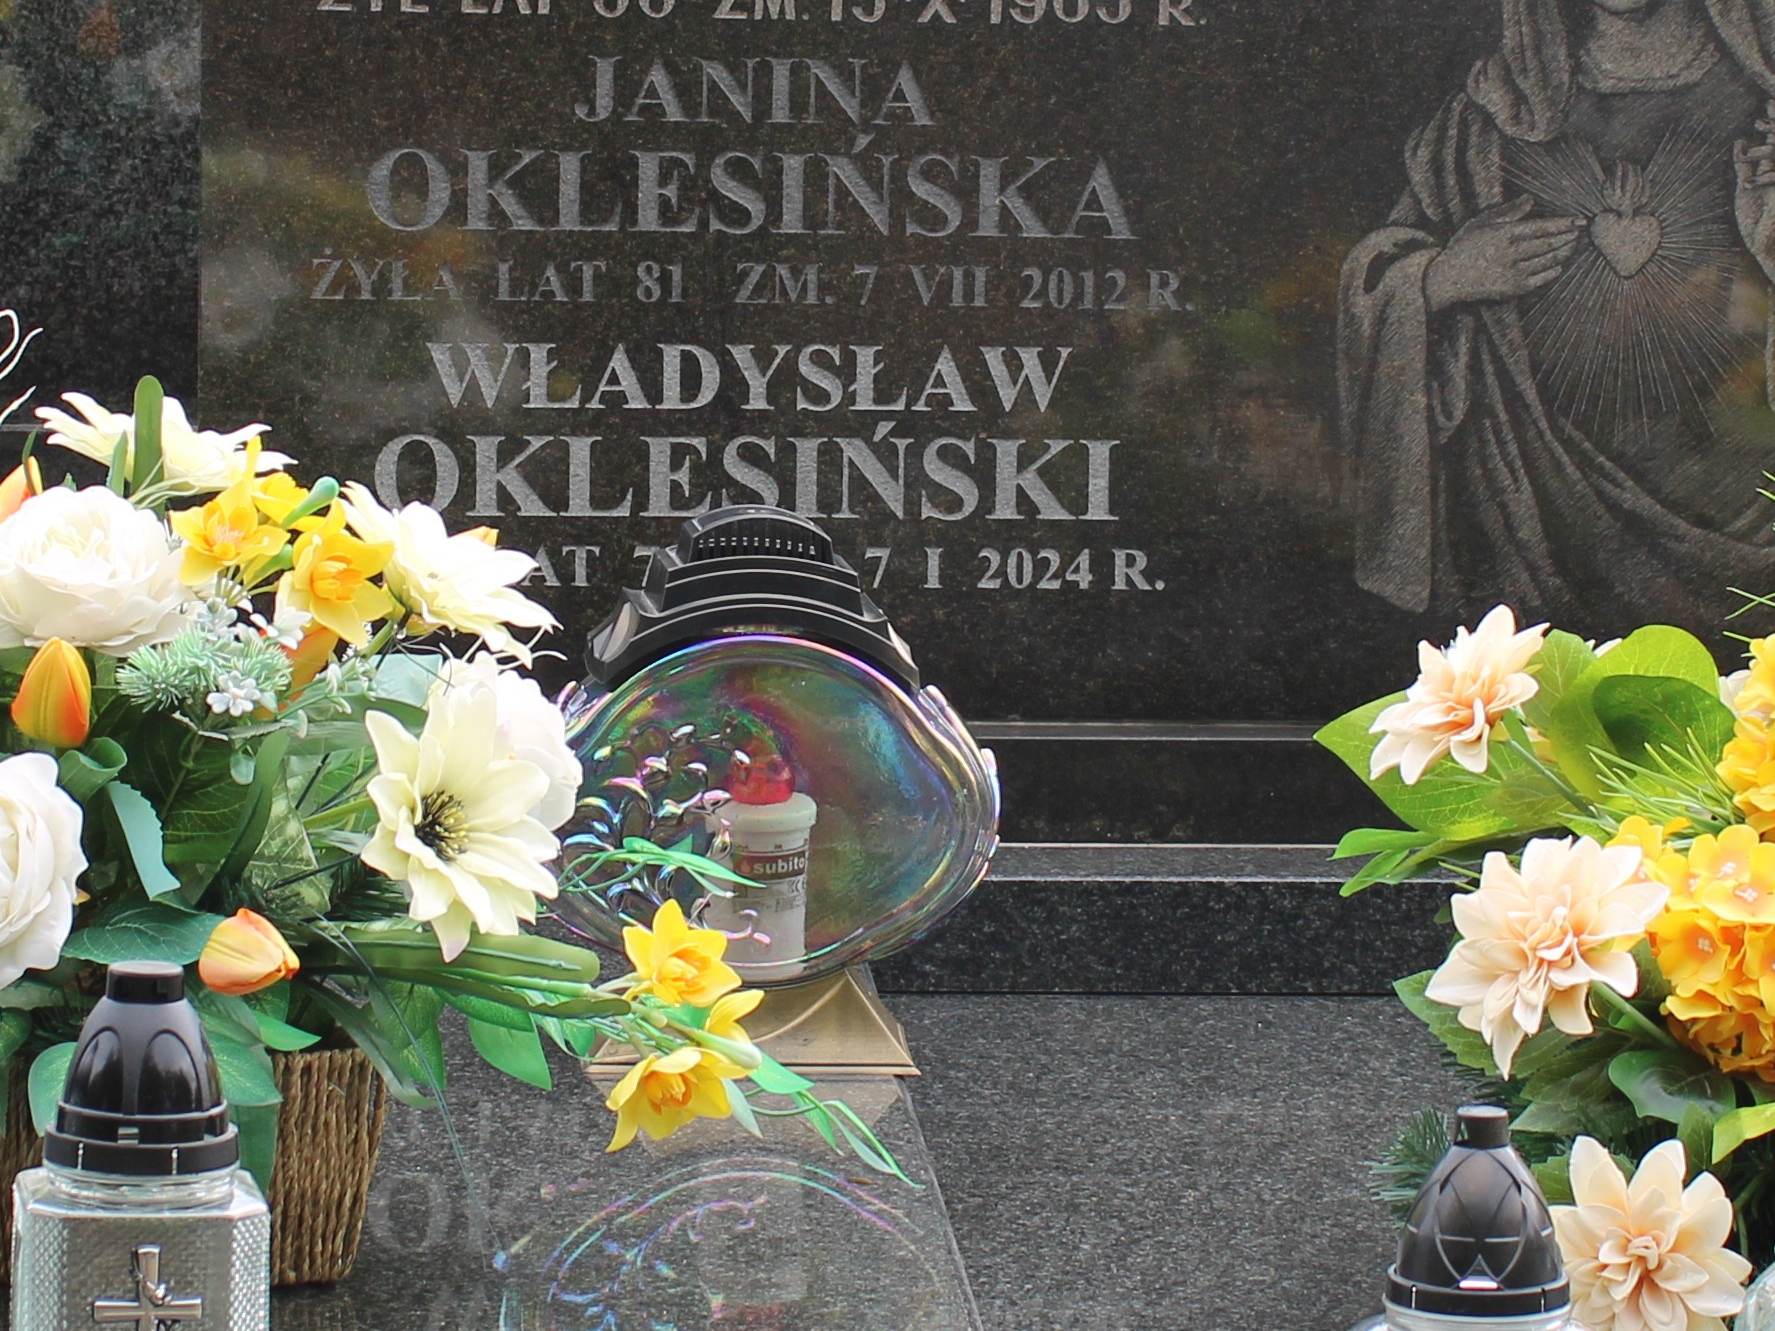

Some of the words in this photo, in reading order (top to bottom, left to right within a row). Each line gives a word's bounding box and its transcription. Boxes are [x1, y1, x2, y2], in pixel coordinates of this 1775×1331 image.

[573, 54, 936, 126] JANINA
[366, 133, 1141, 239] OKLESIŃSKA
[310, 247, 464, 301] ŻYŁA
[495, 260, 607, 302] LAT
[635, 260, 684, 304] 81
[735, 261, 835, 307] ZM.
[850, 266, 876, 306] 7
[910, 264, 992, 309] VII
[1019, 268, 1127, 311] 2012
[1145, 268, 1194, 312] R.
[426, 340, 1072, 415] WŁADYSŁAW
[372, 420, 1121, 522] OKLESIŃSKI
[520, 542, 602, 587] AT
[923, 548, 941, 589] I
[977, 547, 1094, 591] 2024
[1111, 549, 1165, 592] R.
[752, 856, 806, 874] subito
